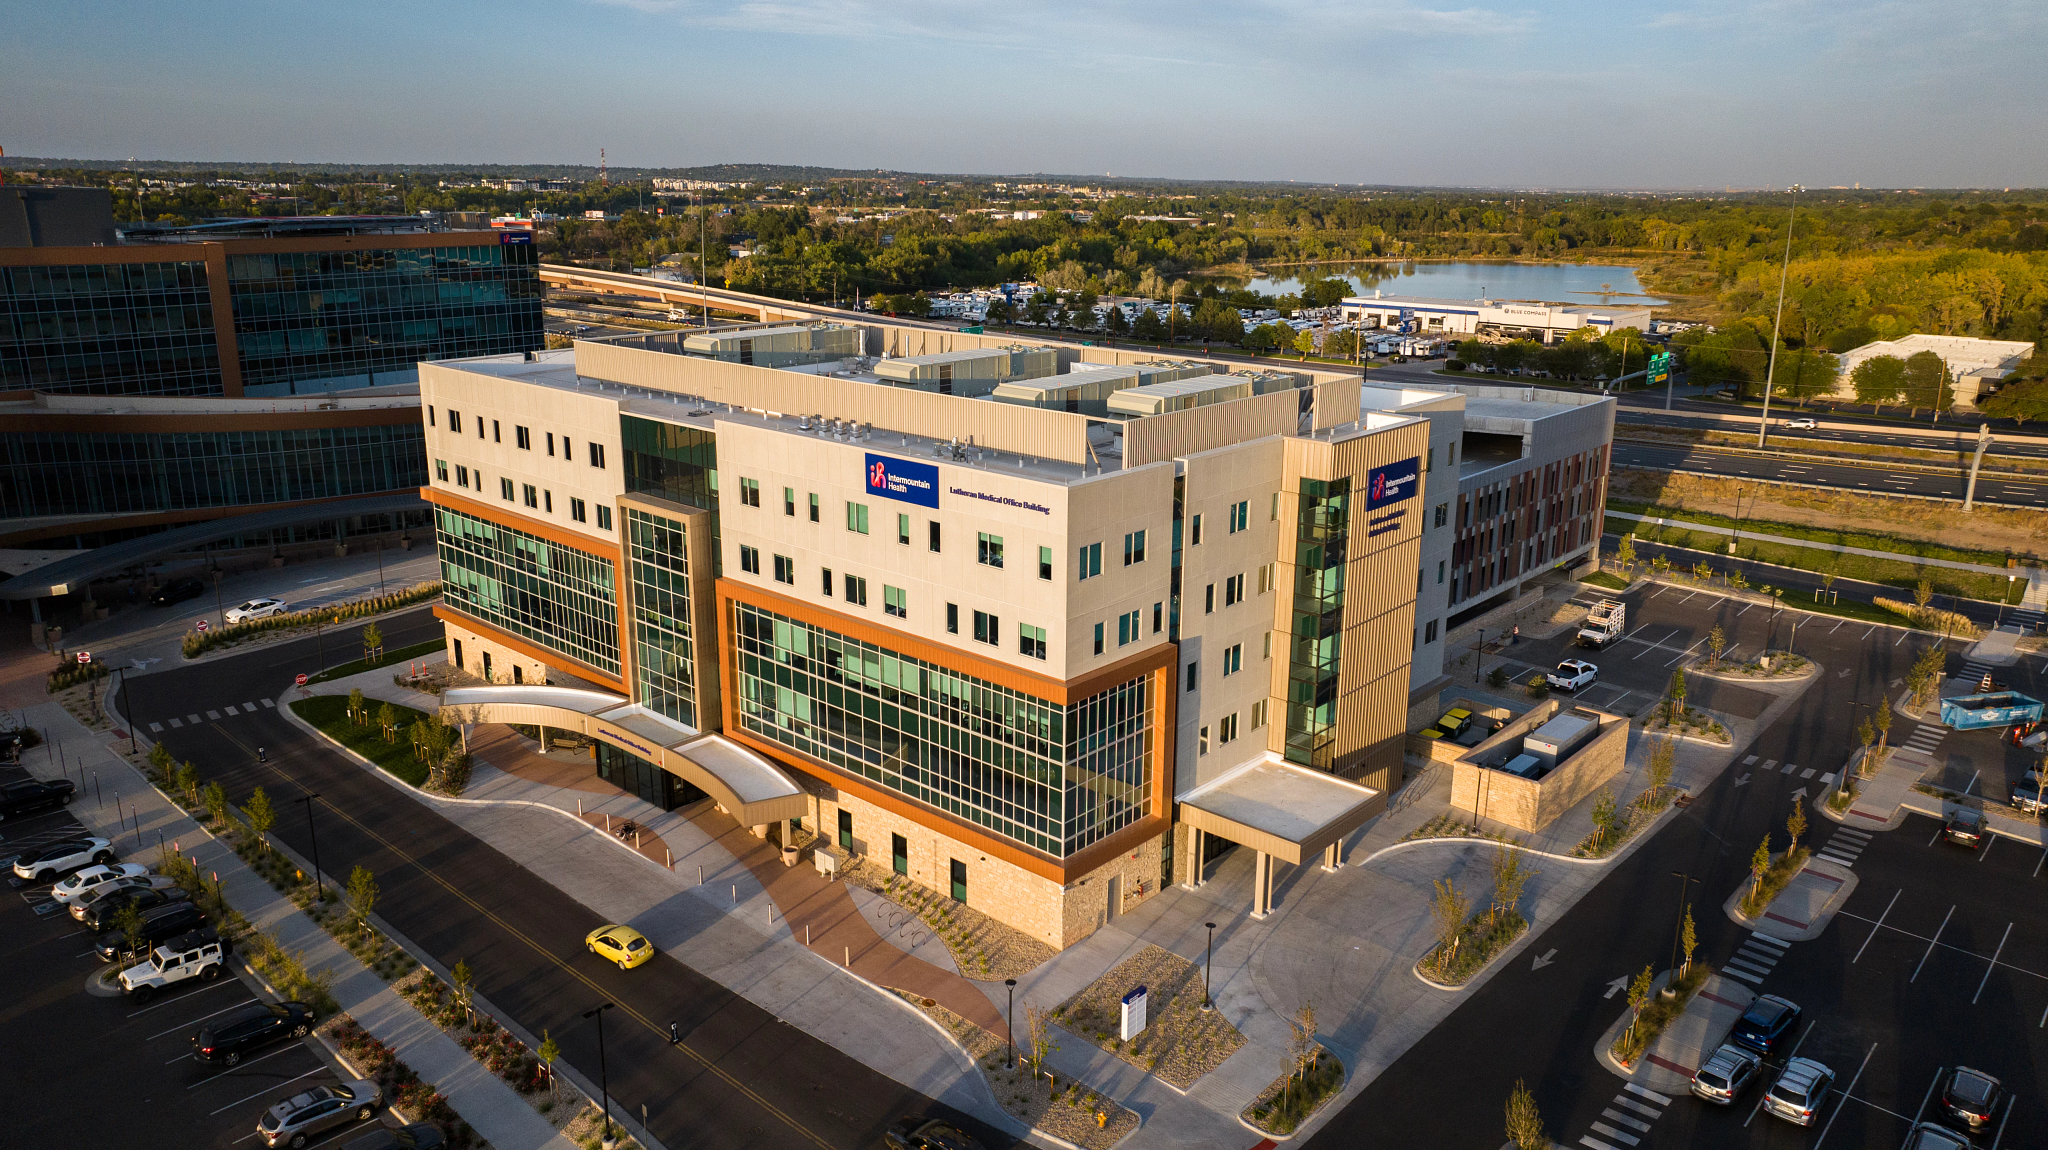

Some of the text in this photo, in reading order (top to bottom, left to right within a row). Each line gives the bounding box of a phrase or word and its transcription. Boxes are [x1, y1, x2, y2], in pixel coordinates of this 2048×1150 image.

[888, 473, 930, 490] Intermountain
[888, 482, 907, 493] Health
[1386, 473, 1415, 488] Intermountain
[1385, 486, 1399, 497] Health
[949, 486, 1050, 516] Lutheran Medical Office Building
